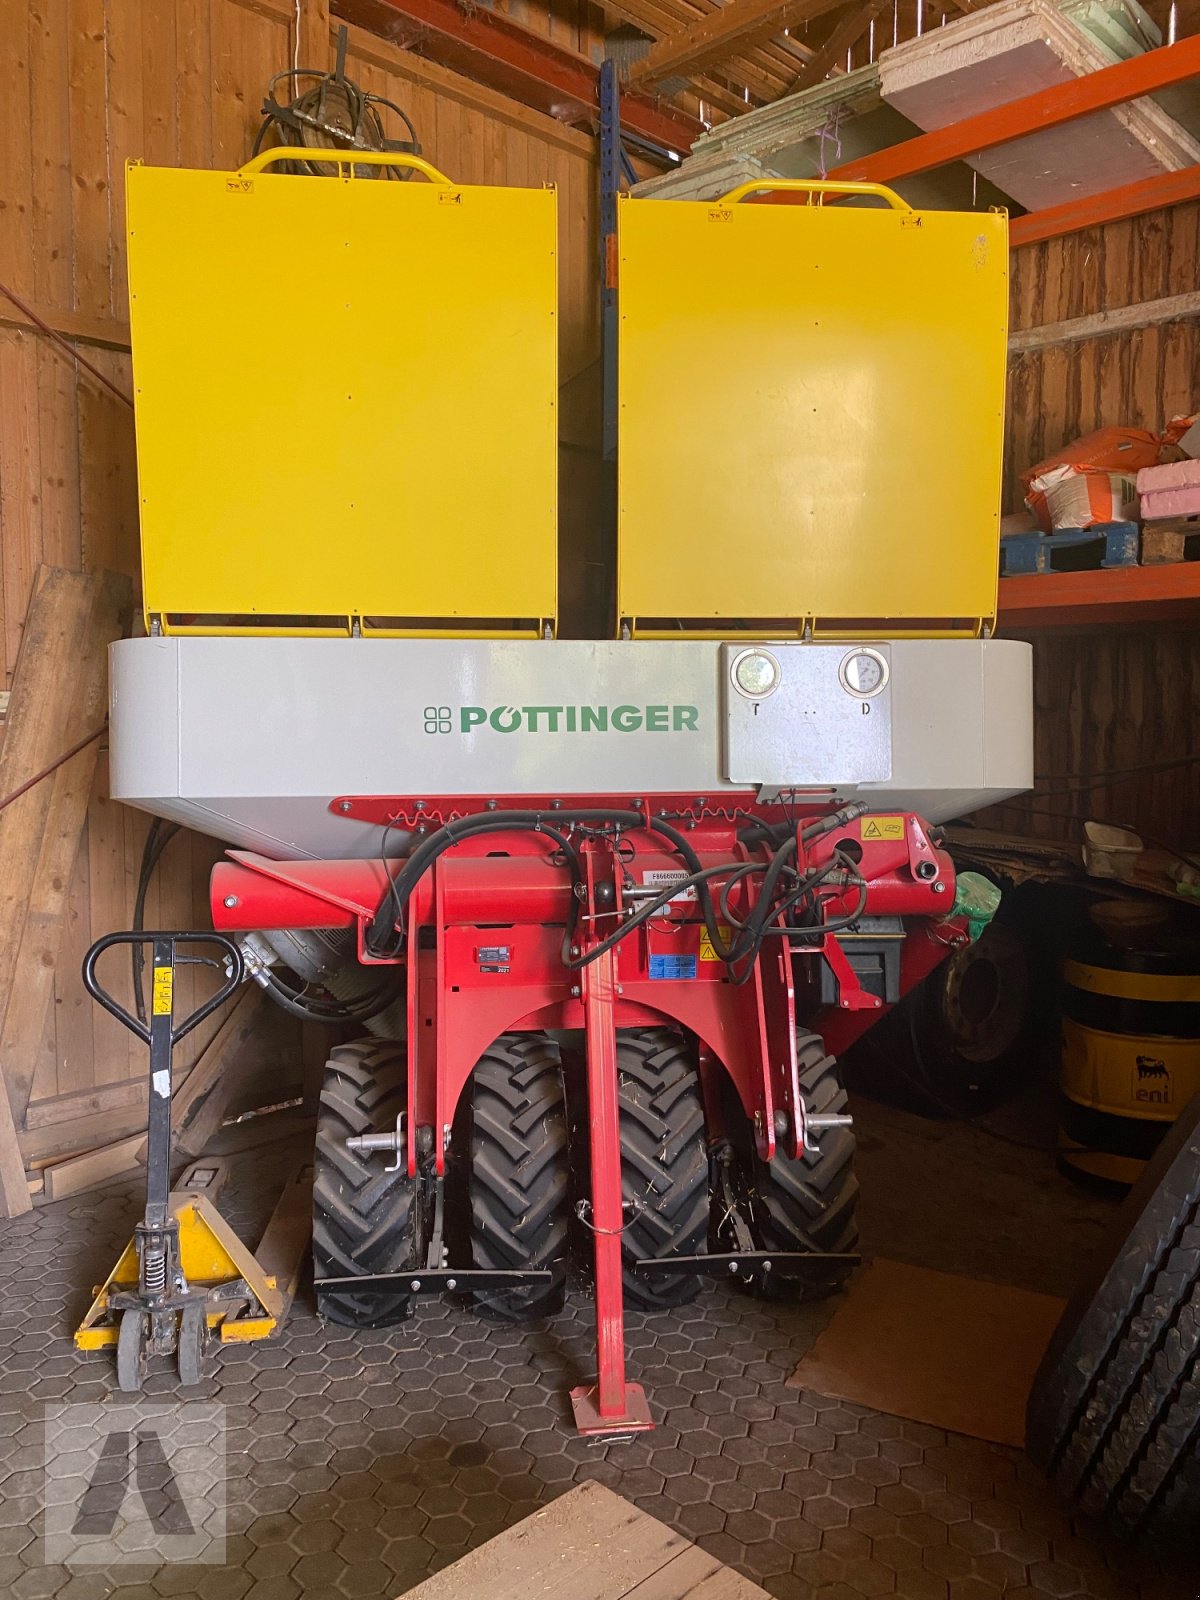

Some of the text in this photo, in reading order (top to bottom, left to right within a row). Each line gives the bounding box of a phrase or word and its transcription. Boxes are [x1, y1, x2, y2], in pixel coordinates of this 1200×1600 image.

[752, 703, 760, 716] T
[862, 702, 871, 715] D
[460, 705, 699, 733] PÖTTINGER
[1135, 1085, 1169, 1104] eni
